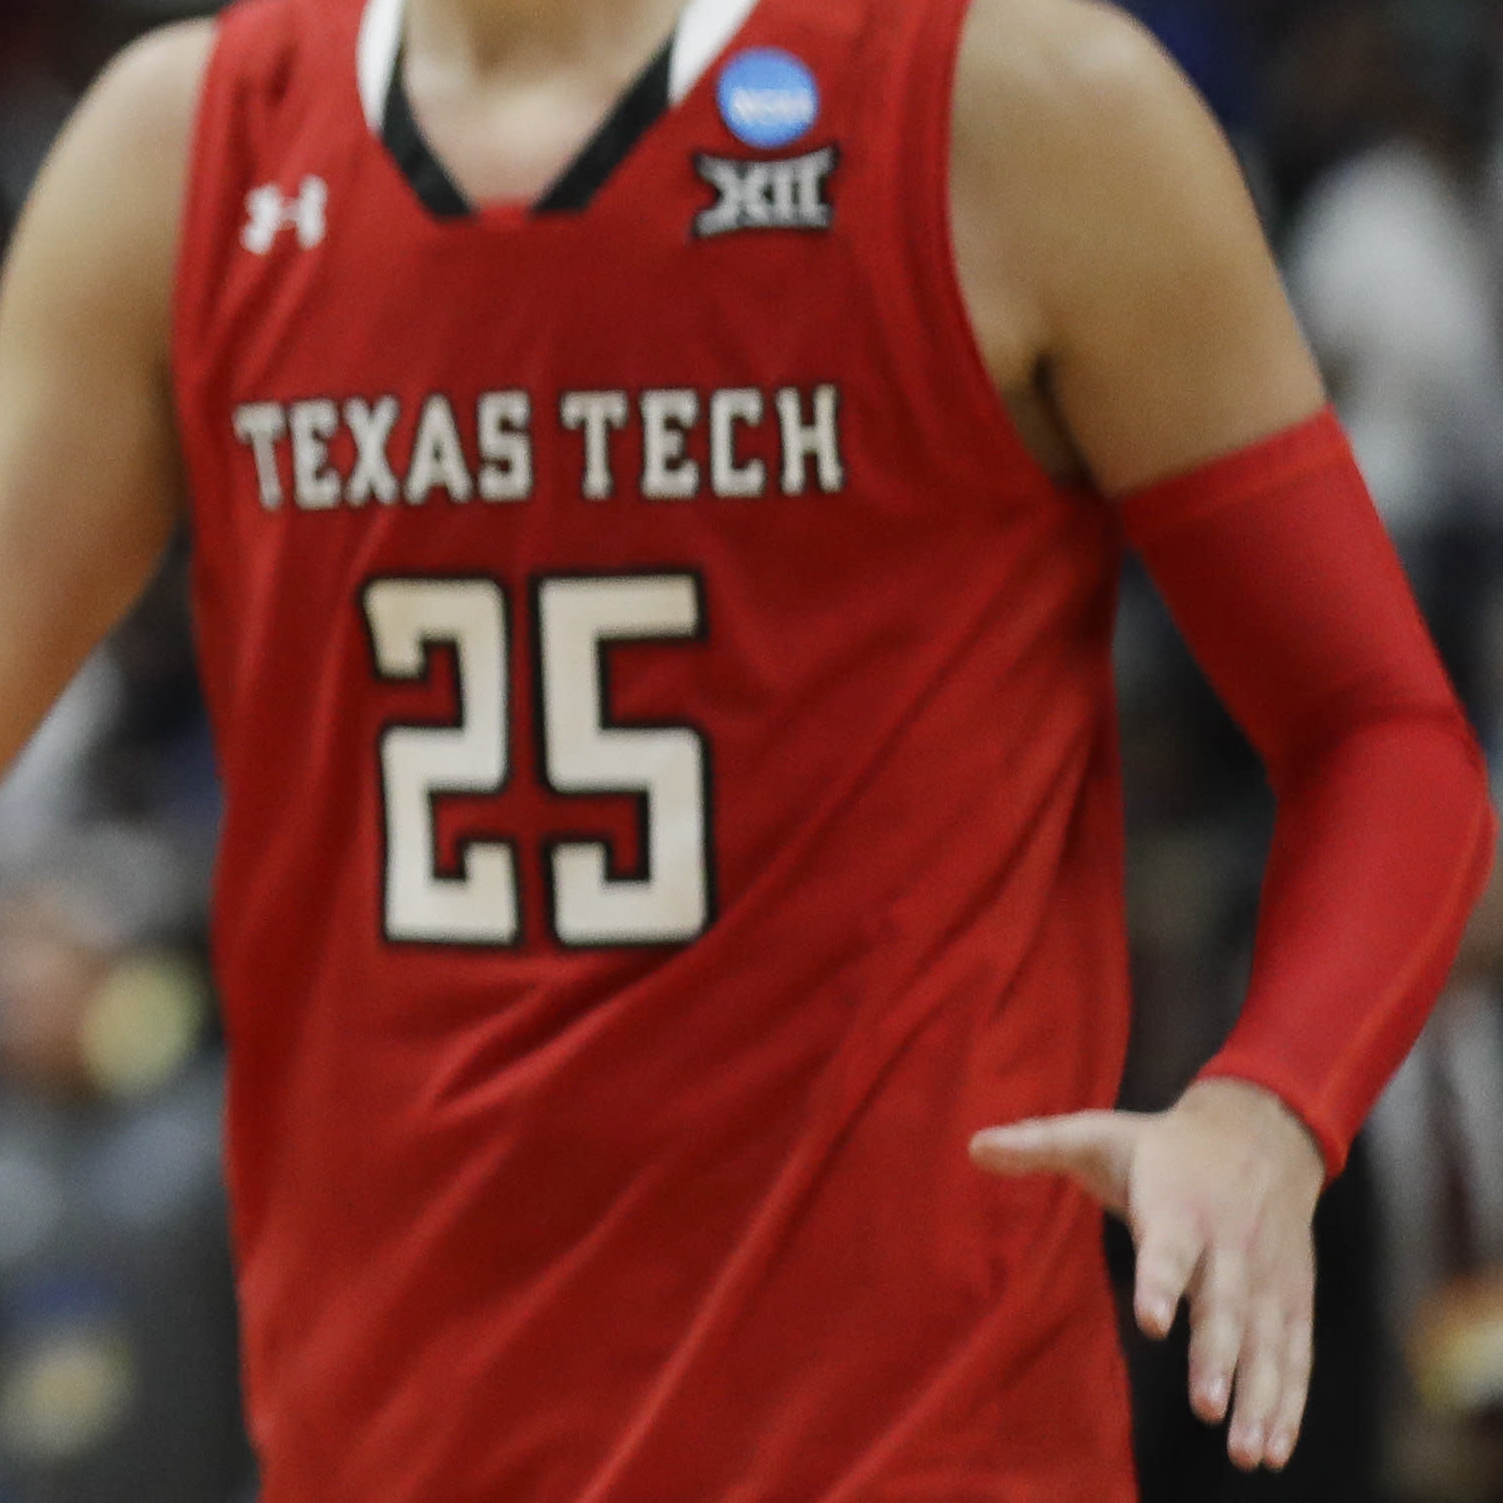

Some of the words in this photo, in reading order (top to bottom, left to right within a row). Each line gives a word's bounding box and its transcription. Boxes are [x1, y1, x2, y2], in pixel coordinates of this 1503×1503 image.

[233, 390, 533, 510] TEXAS
[561, 384, 845, 498] TECH
[359, 571, 717, 948] 25
